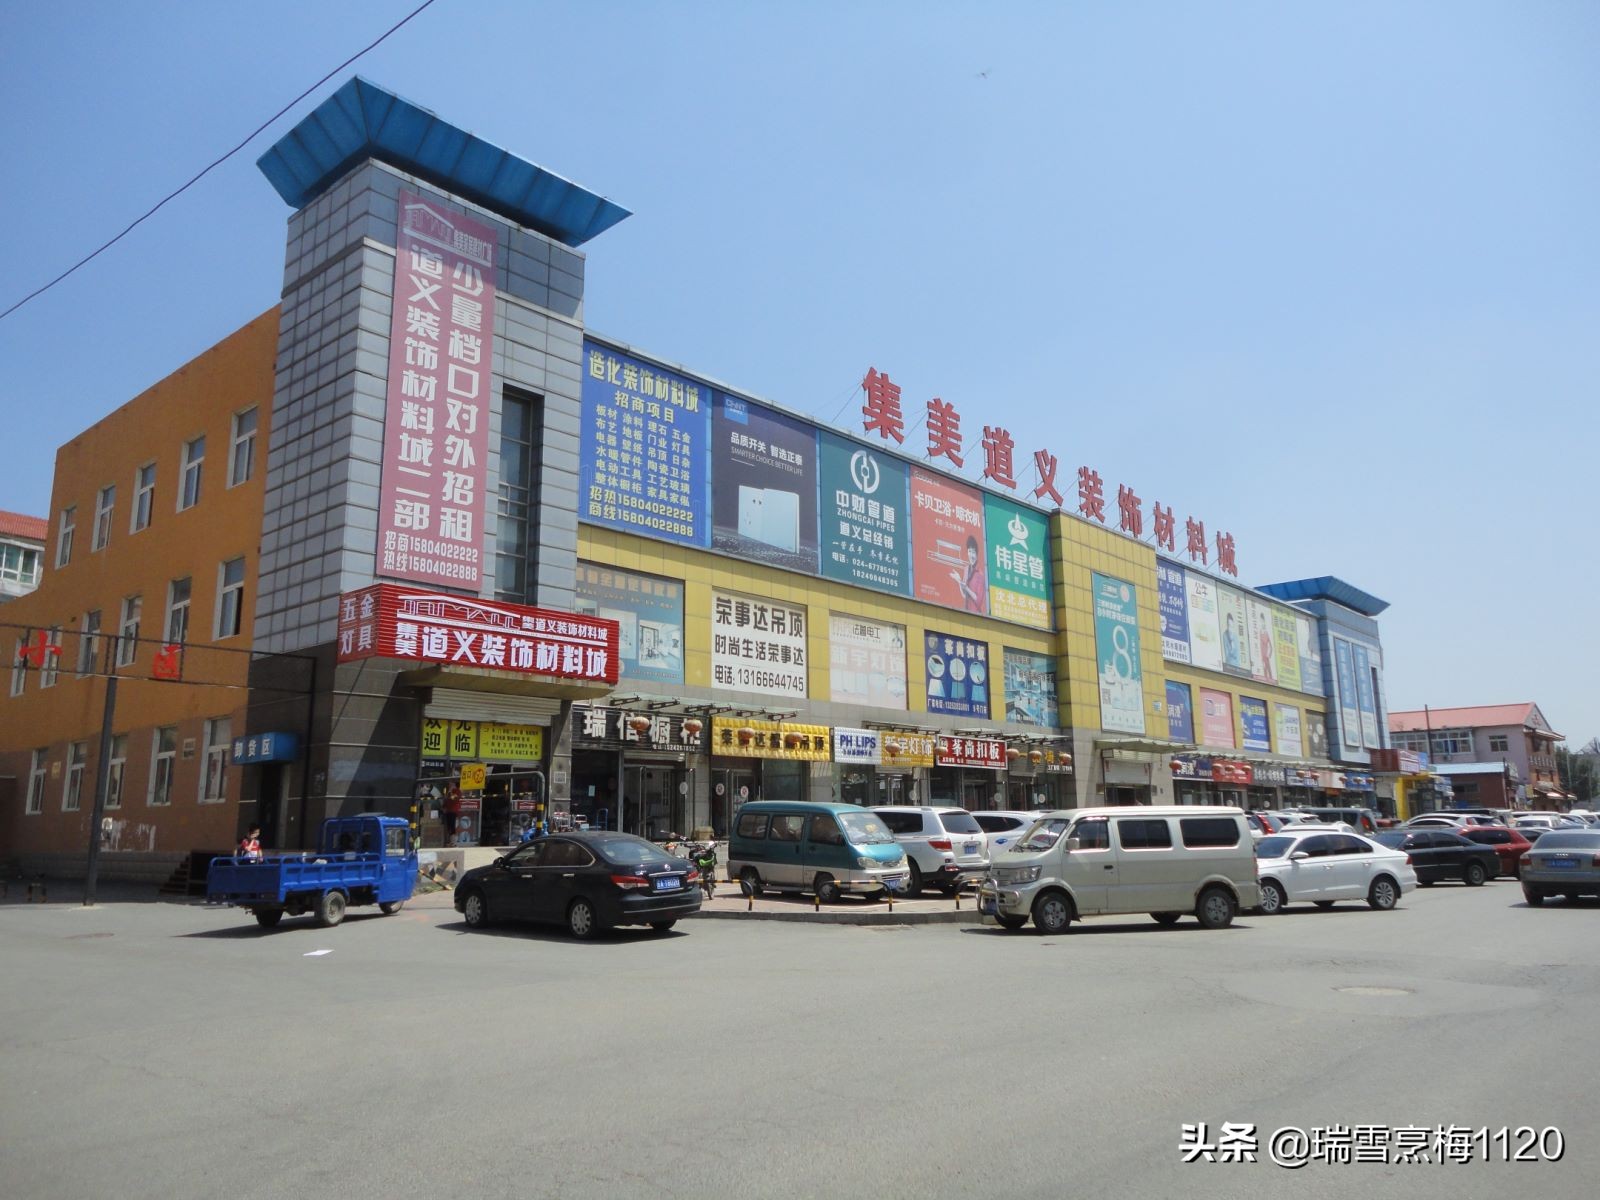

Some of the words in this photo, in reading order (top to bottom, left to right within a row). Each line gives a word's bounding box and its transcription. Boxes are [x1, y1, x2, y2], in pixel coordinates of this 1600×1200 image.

[394, 244, 443, 531] 道义装饰材料城二部
[590, 350, 699, 412] 造化装饰材料城
[439, 257, 484, 542] 少量档口对外招租
[615, 391, 675, 423] 招商项目
[731, 431, 767, 453] 品质开关
[861, 366, 1238, 577] 集美道义装饰材料城
[836, 490, 895, 524] 中财管道
[837, 508, 874, 525] ZHONGCAI
[876, 520, 895, 533] PIPES
[840, 521, 894, 550] 道义总经销
[995, 545, 1044, 580] 伟星管
[343, 593, 374, 624] 五金
[716, 597, 804, 638] 荣事达吊顶
[340, 625, 372, 656] 灯具
[715, 634, 804, 666] 时尚生活荣事达
[233, 740, 274, 758] 卸货区
